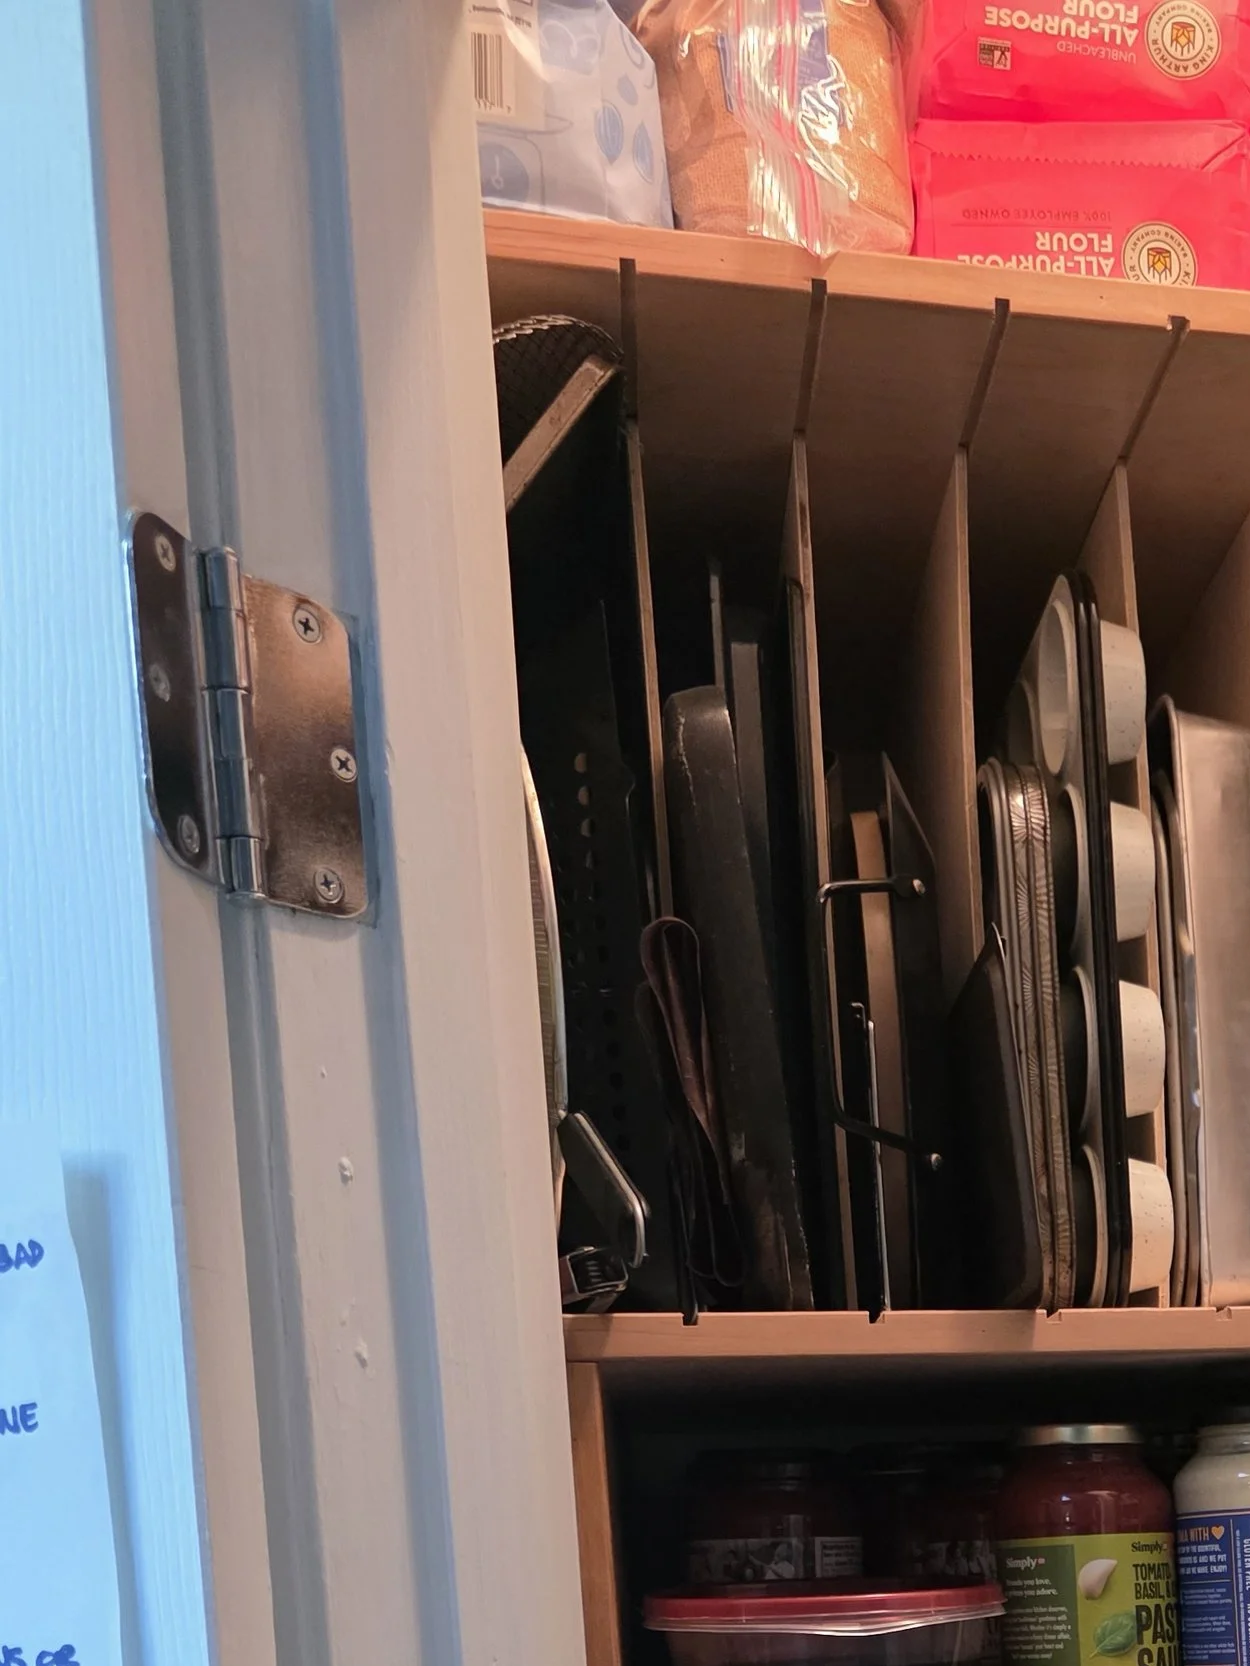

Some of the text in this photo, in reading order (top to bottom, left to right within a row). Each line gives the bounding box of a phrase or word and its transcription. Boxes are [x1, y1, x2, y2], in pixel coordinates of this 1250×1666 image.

[1063, 0, 1139, 24] FLOUR
[984, 6, 1139, 47] ALL-PURPOSE
[1056, 41, 1138, 64] UNBLEACHED
[1035, 231, 1113, 252] FLOUR
[1131, 1540, 1163, 1554] Simply
[1006, 1556, 1037, 1570] Simply
